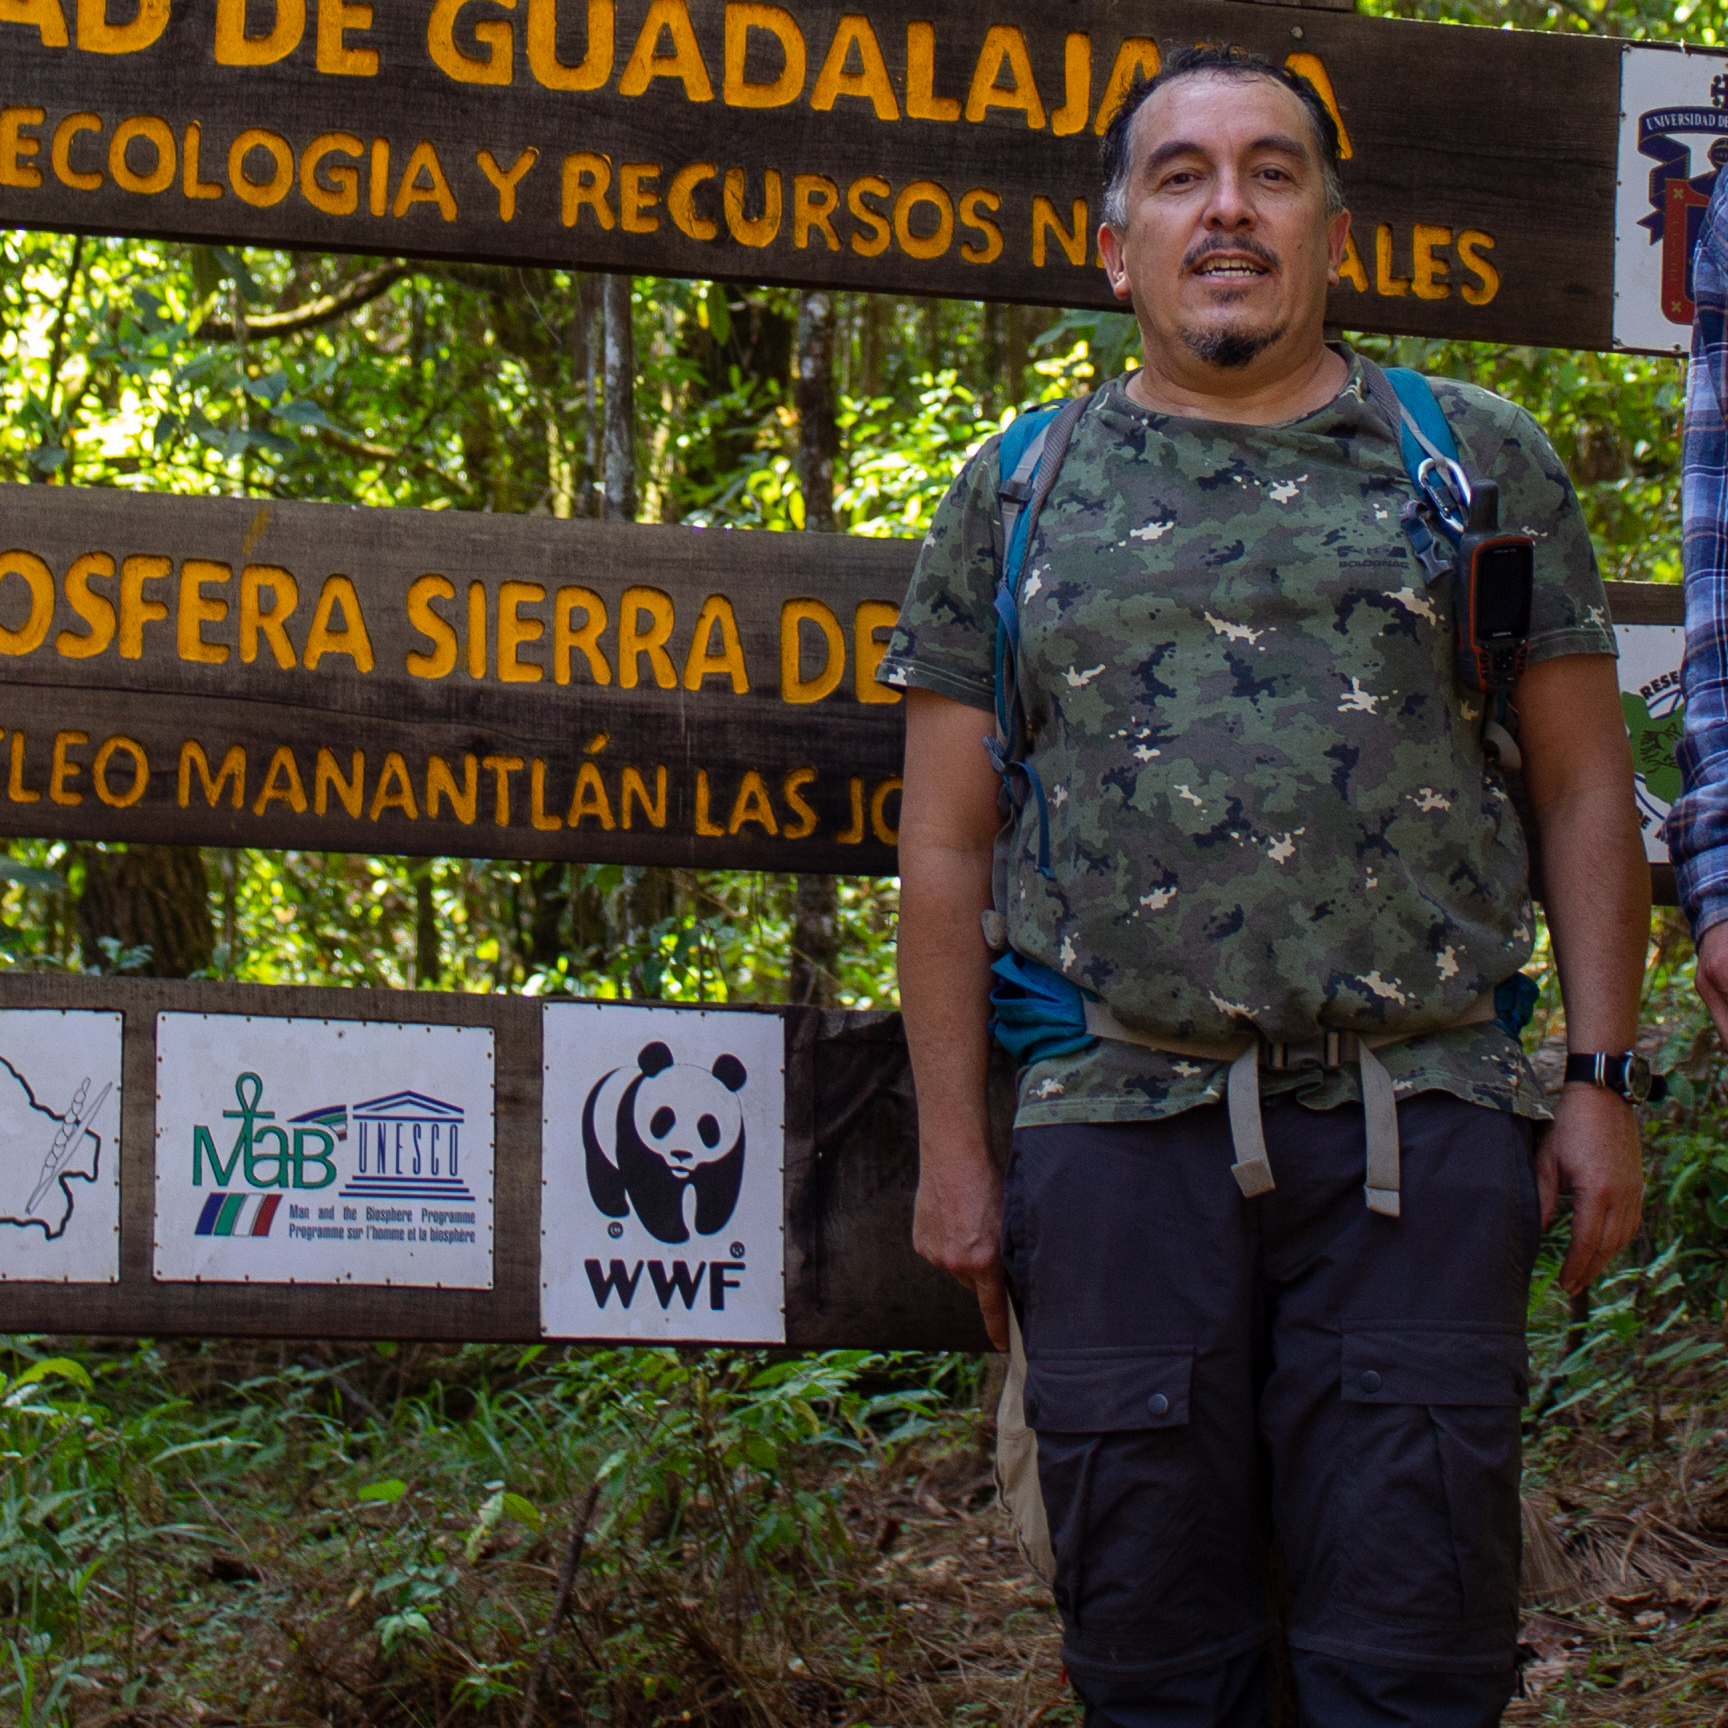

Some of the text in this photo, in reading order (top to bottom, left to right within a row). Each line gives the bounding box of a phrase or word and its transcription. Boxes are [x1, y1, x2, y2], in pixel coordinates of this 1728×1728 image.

[1645, 113, 1715, 130] UNIVERSIDAD
[476, 146, 540, 223] Y
[561, 152, 1004, 264] RECURSOS
[405, 572, 750, 695] SIERRA
[780, 596, 902, 705] DE
[178, 730, 667, 831] MANANTLÁN
[695, 767, 820, 839] LAS
[358, 1122, 459, 1176] UNESCO
[289, 1204, 476, 1225] Man and the Biosphere Programme
[289, 1223, 344, 1242] Programme
[347, 1226, 363, 1239] sur
[366, 1225, 405, 1241] l'homme
[407, 1227, 416, 1241] et
[419, 1227, 427, 1241] la
[584, 1258, 746, 1310] WWF
